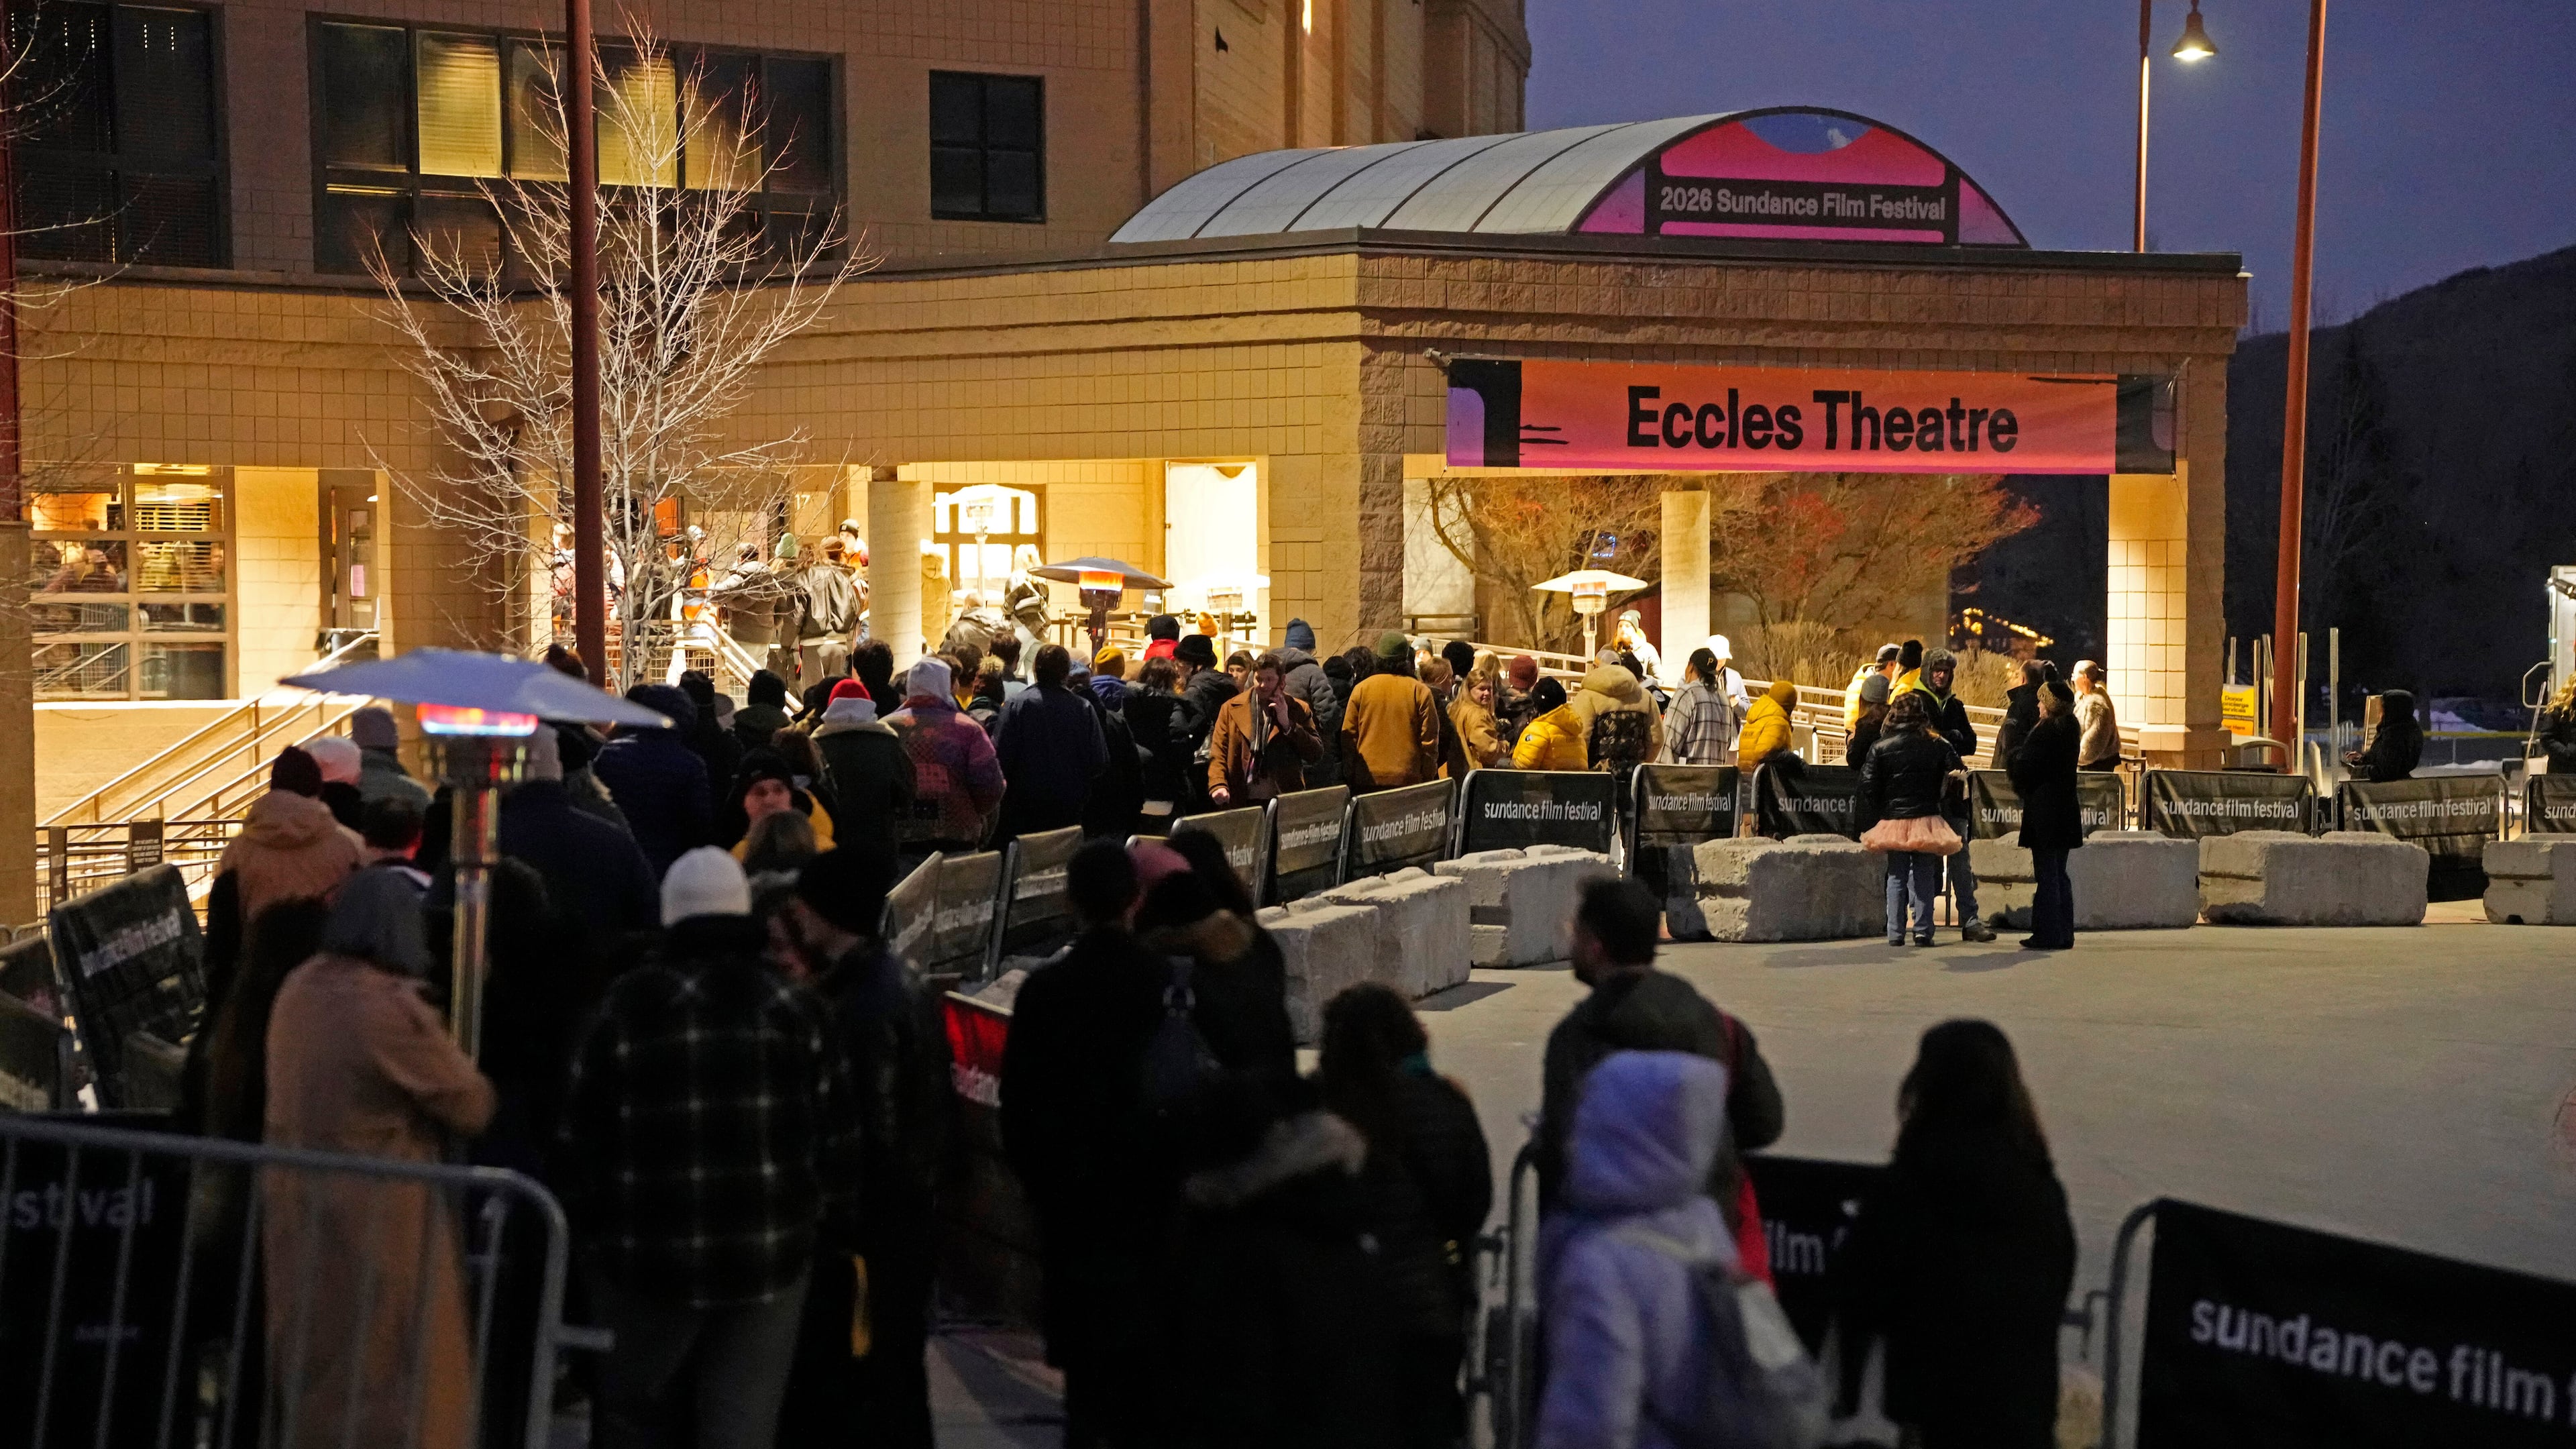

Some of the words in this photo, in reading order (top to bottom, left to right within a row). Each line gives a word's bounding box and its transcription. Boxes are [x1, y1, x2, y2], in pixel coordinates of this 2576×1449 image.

[1660, 186, 1713, 212] 2026
[1716, 189, 1818, 215] Sundance
[1823, 193, 1866, 218] Film
[1870, 194, 1945, 221] Festival
[1627, 386, 1803, 451] Eccles
[1813, 390, 2019, 453] Theatre
[795, 494, 810, 510] 17
[1485, 800, 1540, 820] sundance
[1541, 800, 1563, 820] film
[1564, 800, 1602, 821] festival
[1688, 792, 1705, 811] film
[1705, 792, 1731, 811] festival
[1778, 795, 1846, 813] sundance
[2162, 798, 2224, 816] sundance
[2225, 799, 2251, 817] film
[2253, 800, 2299, 818] festival
[2354, 803, 2416, 821] sundance
[2418, 800, 2444, 818] film
[2445, 798, 2491, 816] festival
[1405, 813, 1420, 835] film
[1420, 806, 1446, 832] festival
[2190, 1299, 2439, 1394] sundance
[2449, 1344, 2556, 1421] film
